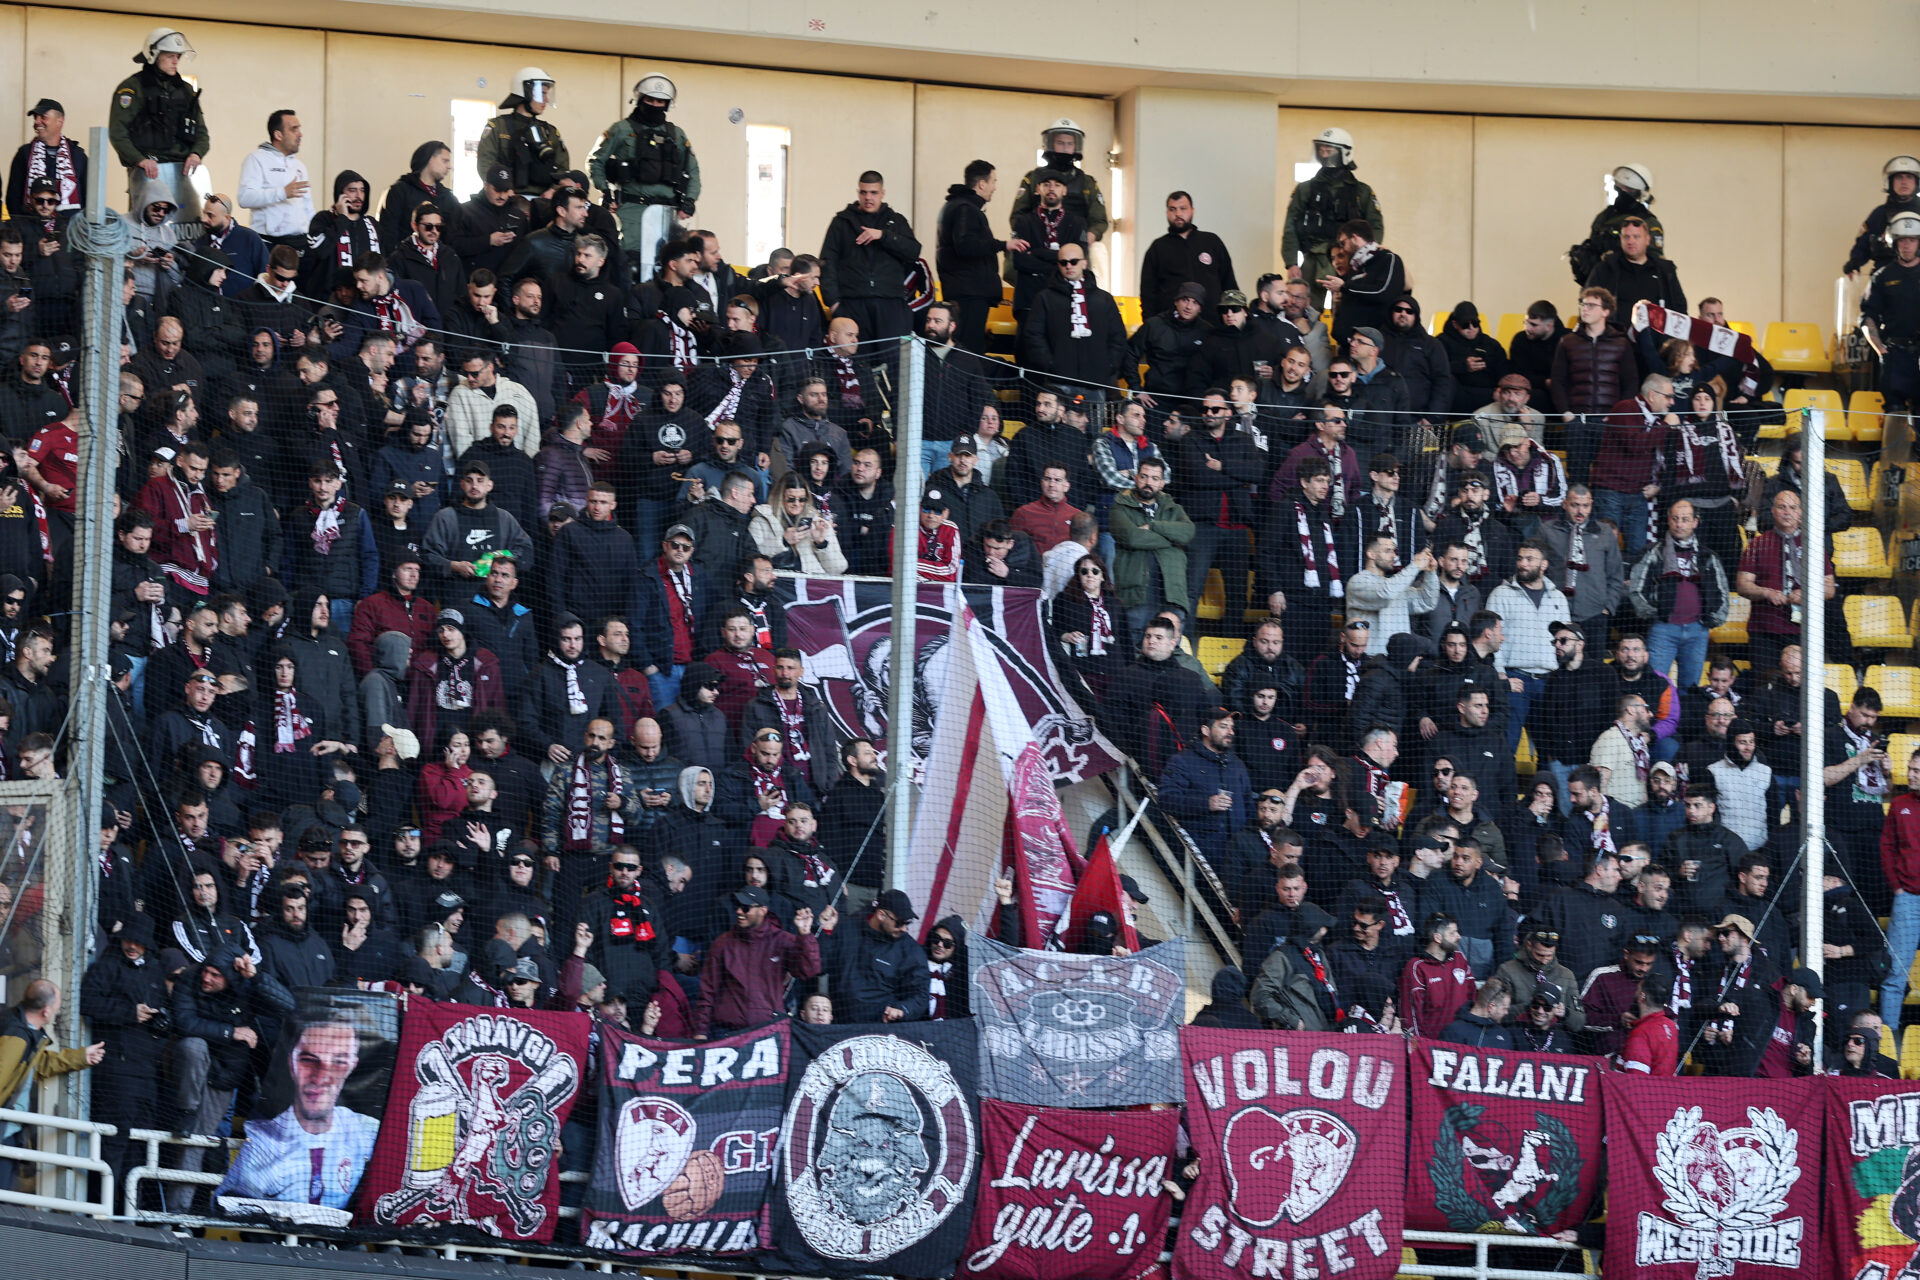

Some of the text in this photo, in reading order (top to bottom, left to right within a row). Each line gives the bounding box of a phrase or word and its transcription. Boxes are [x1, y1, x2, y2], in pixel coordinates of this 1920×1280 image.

[618, 1036, 780, 1086] PERA
[1192, 1046, 1395, 1111] VOLOU
[1428, 1049, 1589, 1103] FALANI
[990, 1114, 1168, 1197] Larissa
[967, 1194, 1094, 1272] gate
[1190, 1203, 1390, 1280] STREET
